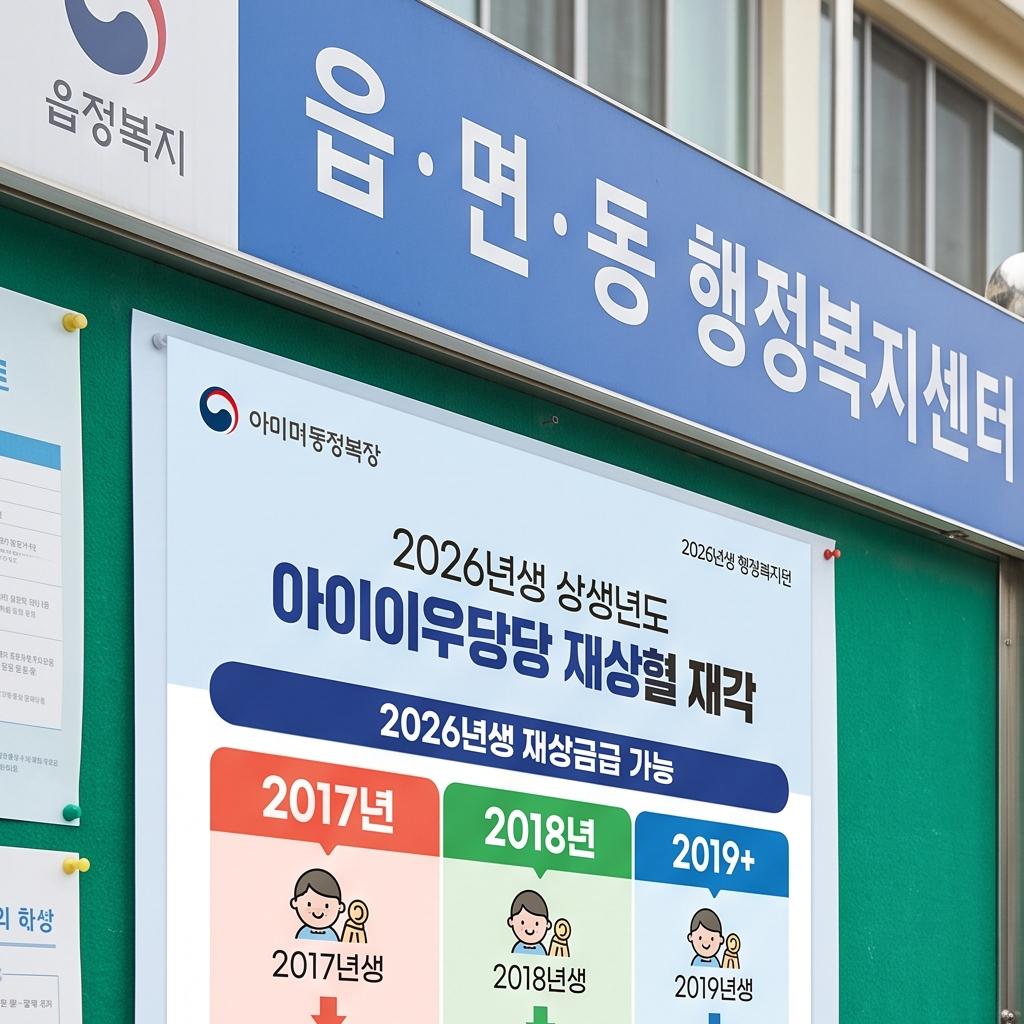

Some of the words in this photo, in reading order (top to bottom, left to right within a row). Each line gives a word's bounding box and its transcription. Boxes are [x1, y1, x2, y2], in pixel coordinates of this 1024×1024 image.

[44, 79, 186, 177] 읍정복지
[688, 223, 1014, 484] 행정복지센터
[249, 410, 382, 468] 아미며동정복장
[393, 527, 546, 603] 2026년생
[556, 571, 669, 635] 상생년도
[272, 561, 553, 680] 아이이우당당
[688, 658, 757, 725] 재각
[379, 702, 515, 759] 2026년생
[522, 726, 622, 777] 재상금급
[629, 747, 675, 785] 가능
[261, 774, 394, 835] 2017년
[484, 805, 595, 859] 2018년
[672, 832, 756, 876] 2019+
[271, 949, 384, 984] 2017년생
[493, 963, 587, 994] 2018년생
[674, 974, 754, 1002] 2019년생
